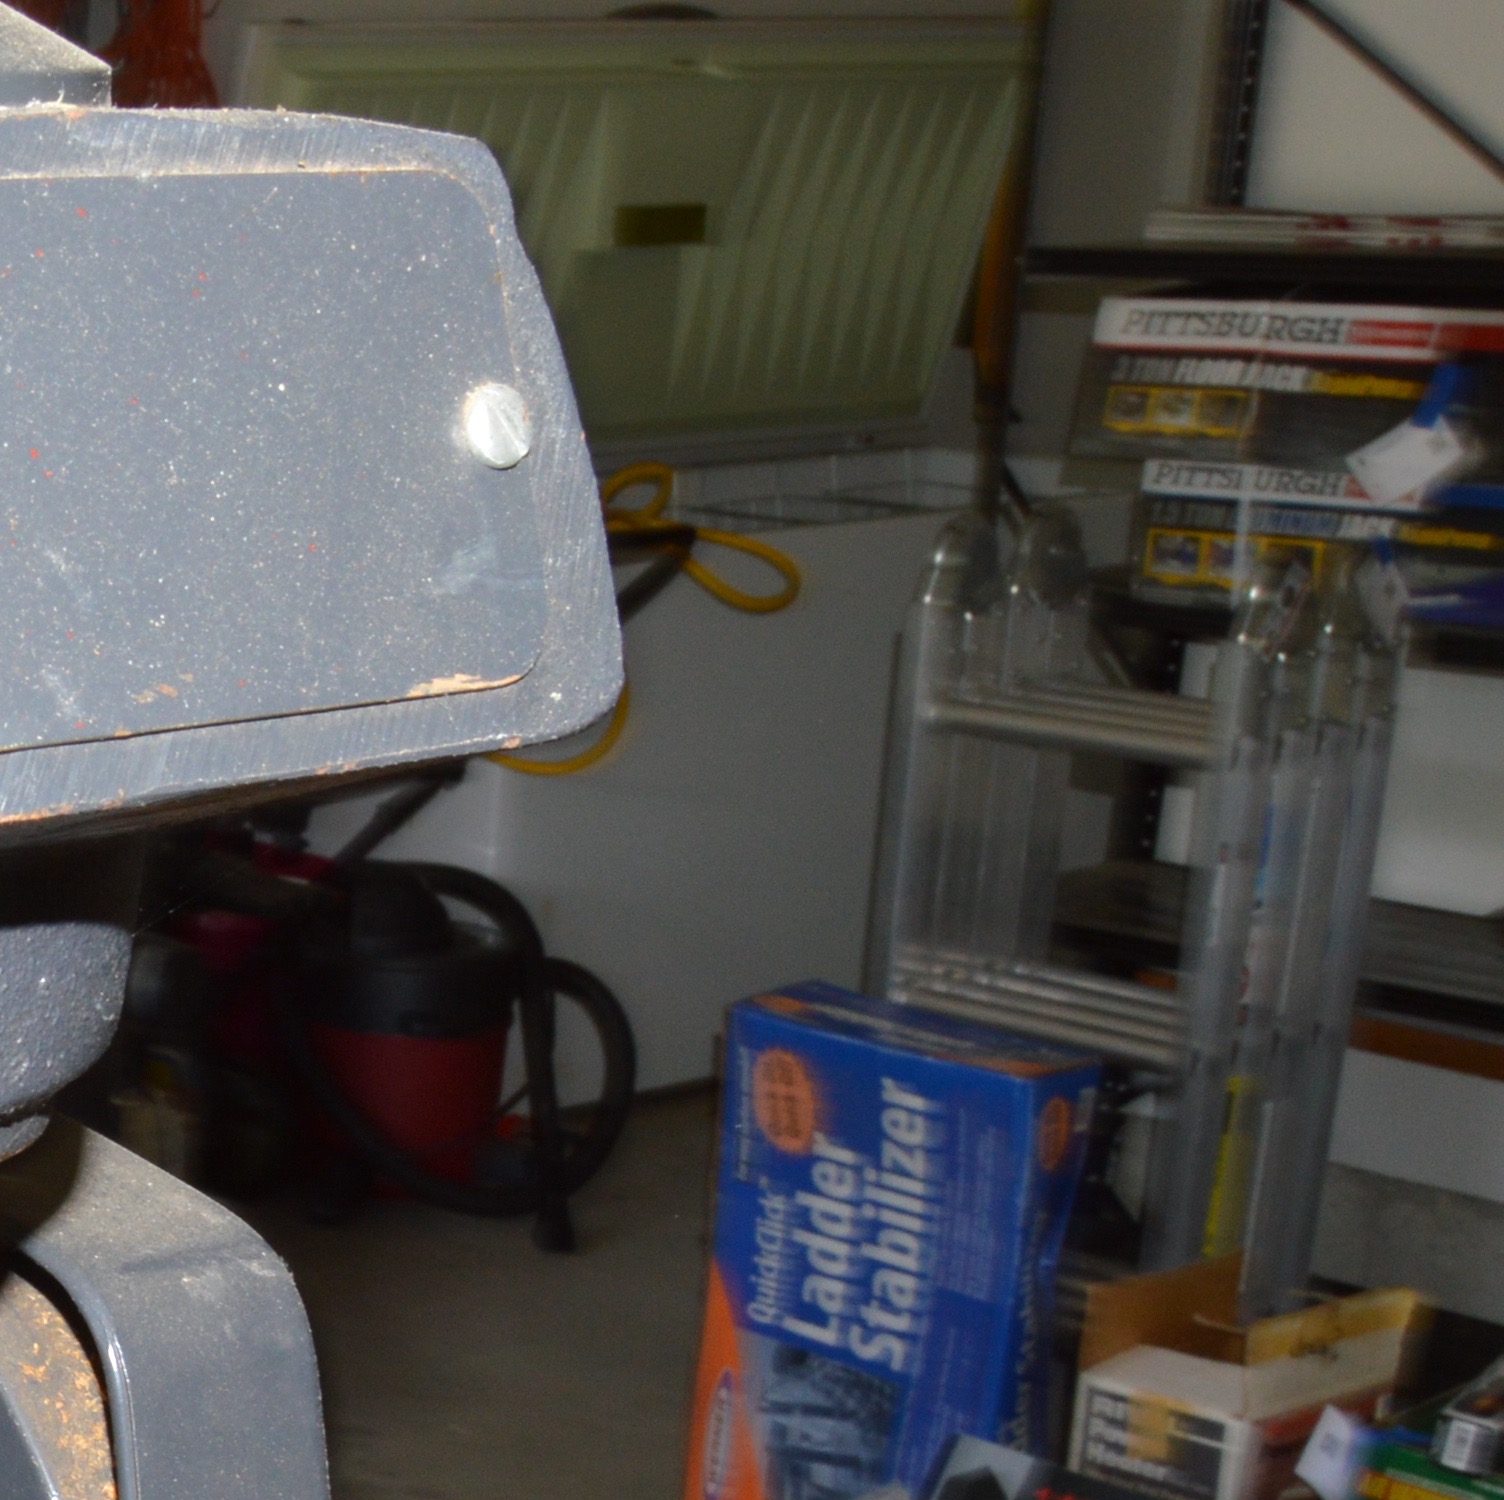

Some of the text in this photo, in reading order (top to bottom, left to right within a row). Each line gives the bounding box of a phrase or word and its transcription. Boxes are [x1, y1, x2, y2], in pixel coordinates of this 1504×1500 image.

[1118, 309, 1344, 346] PITTSBURGH
[1152, 463, 1342, 497] PITTSURGH
[782, 1131, 859, 1347] Ladder
[849, 1077, 937, 1371] Stabilizer
